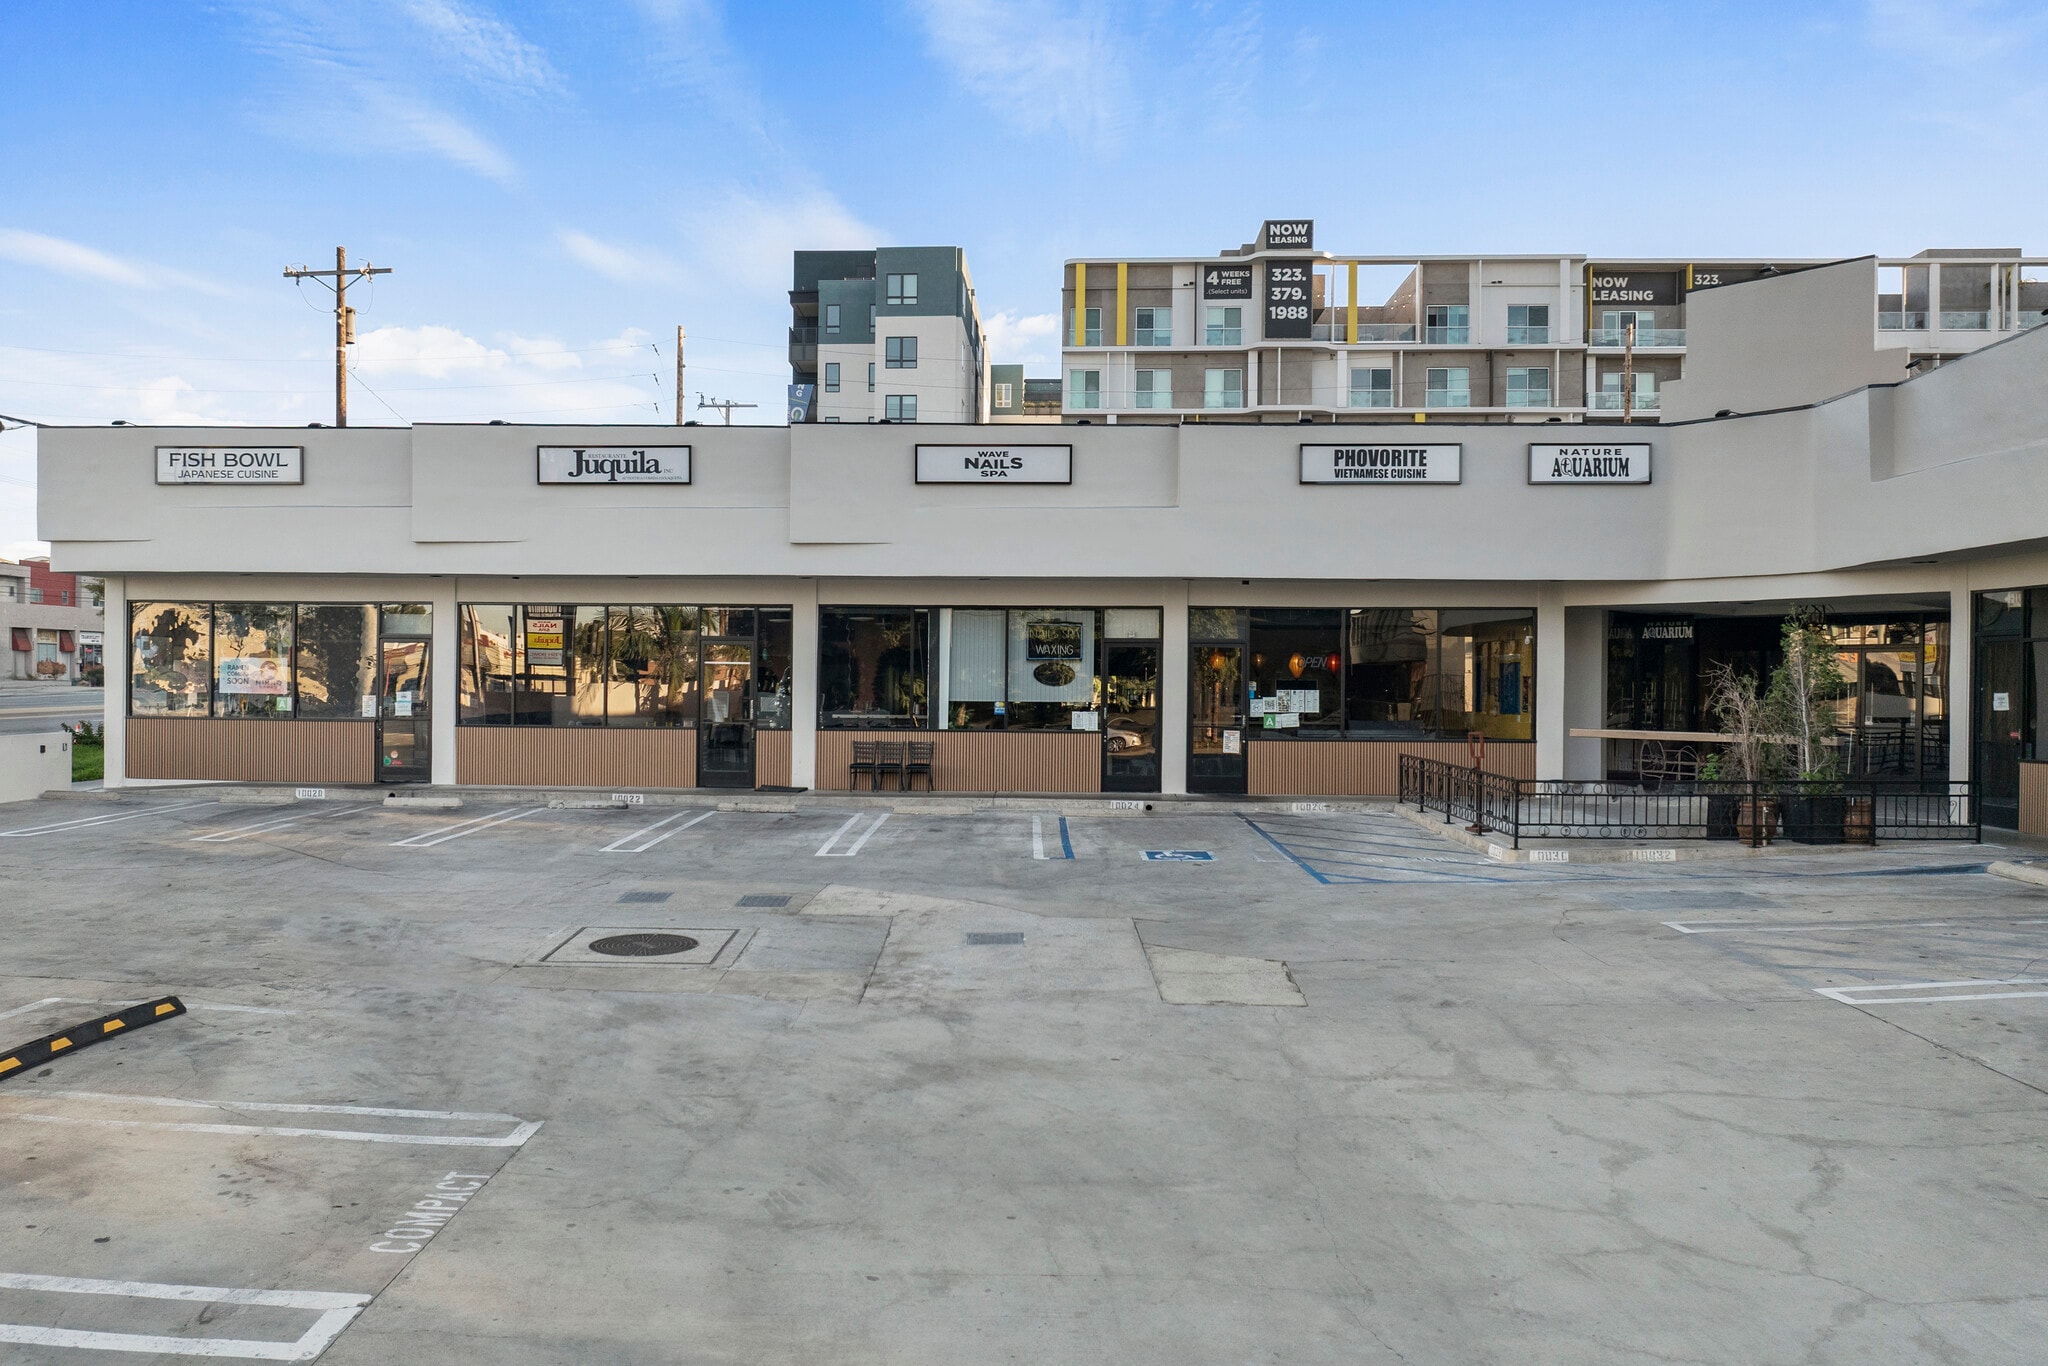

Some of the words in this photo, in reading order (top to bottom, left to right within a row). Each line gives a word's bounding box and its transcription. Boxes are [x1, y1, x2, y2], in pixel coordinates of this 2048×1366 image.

[1269, 223, 1308, 236] NOW
[1269, 236, 1308, 244] LEASING
[1206, 271, 1219, 286] 4
[1221, 270, 1250, 278] WEEKS
[1271, 268, 1307, 281] 323.
[1694, 274, 1722, 285] 323.
[1221, 278, 1242, 286] FREE
[1592, 277, 1628, 288] NOW
[1271, 287, 1307, 300] 379.
[1592, 290, 1654, 301] LEASING
[1269, 306, 1308, 320] 1988
[1333, 449, 1428, 467] PHOVORITE
[1559, 448, 1622, 456] NATURE
[169, 452, 216, 467] FISH
[223, 452, 288, 467] BOWL
[568, 449, 662, 481] Juquila
[964, 457, 1023, 469] NAILS
[1551, 457, 1630, 477] AQUARIUM
[178, 470, 234, 479] JAPANESE
[237, 470, 279, 479] CUISINE
[1334, 468, 1389, 479] VIETNAMESE
[1390, 468, 1427, 479] CUISINE
[1641, 626, 1693, 639] AQUARIUM
[1035, 644, 1074, 656] WAXING
[1298, 656, 1328, 669] OPEN
[227, 677, 250, 685] SOON
[278, 699, 286, 709] A
[1265, 717, 1275, 726] A
[1111, 801, 1139, 810] 10024
[369, 1171, 490, 1254] COMPACT
